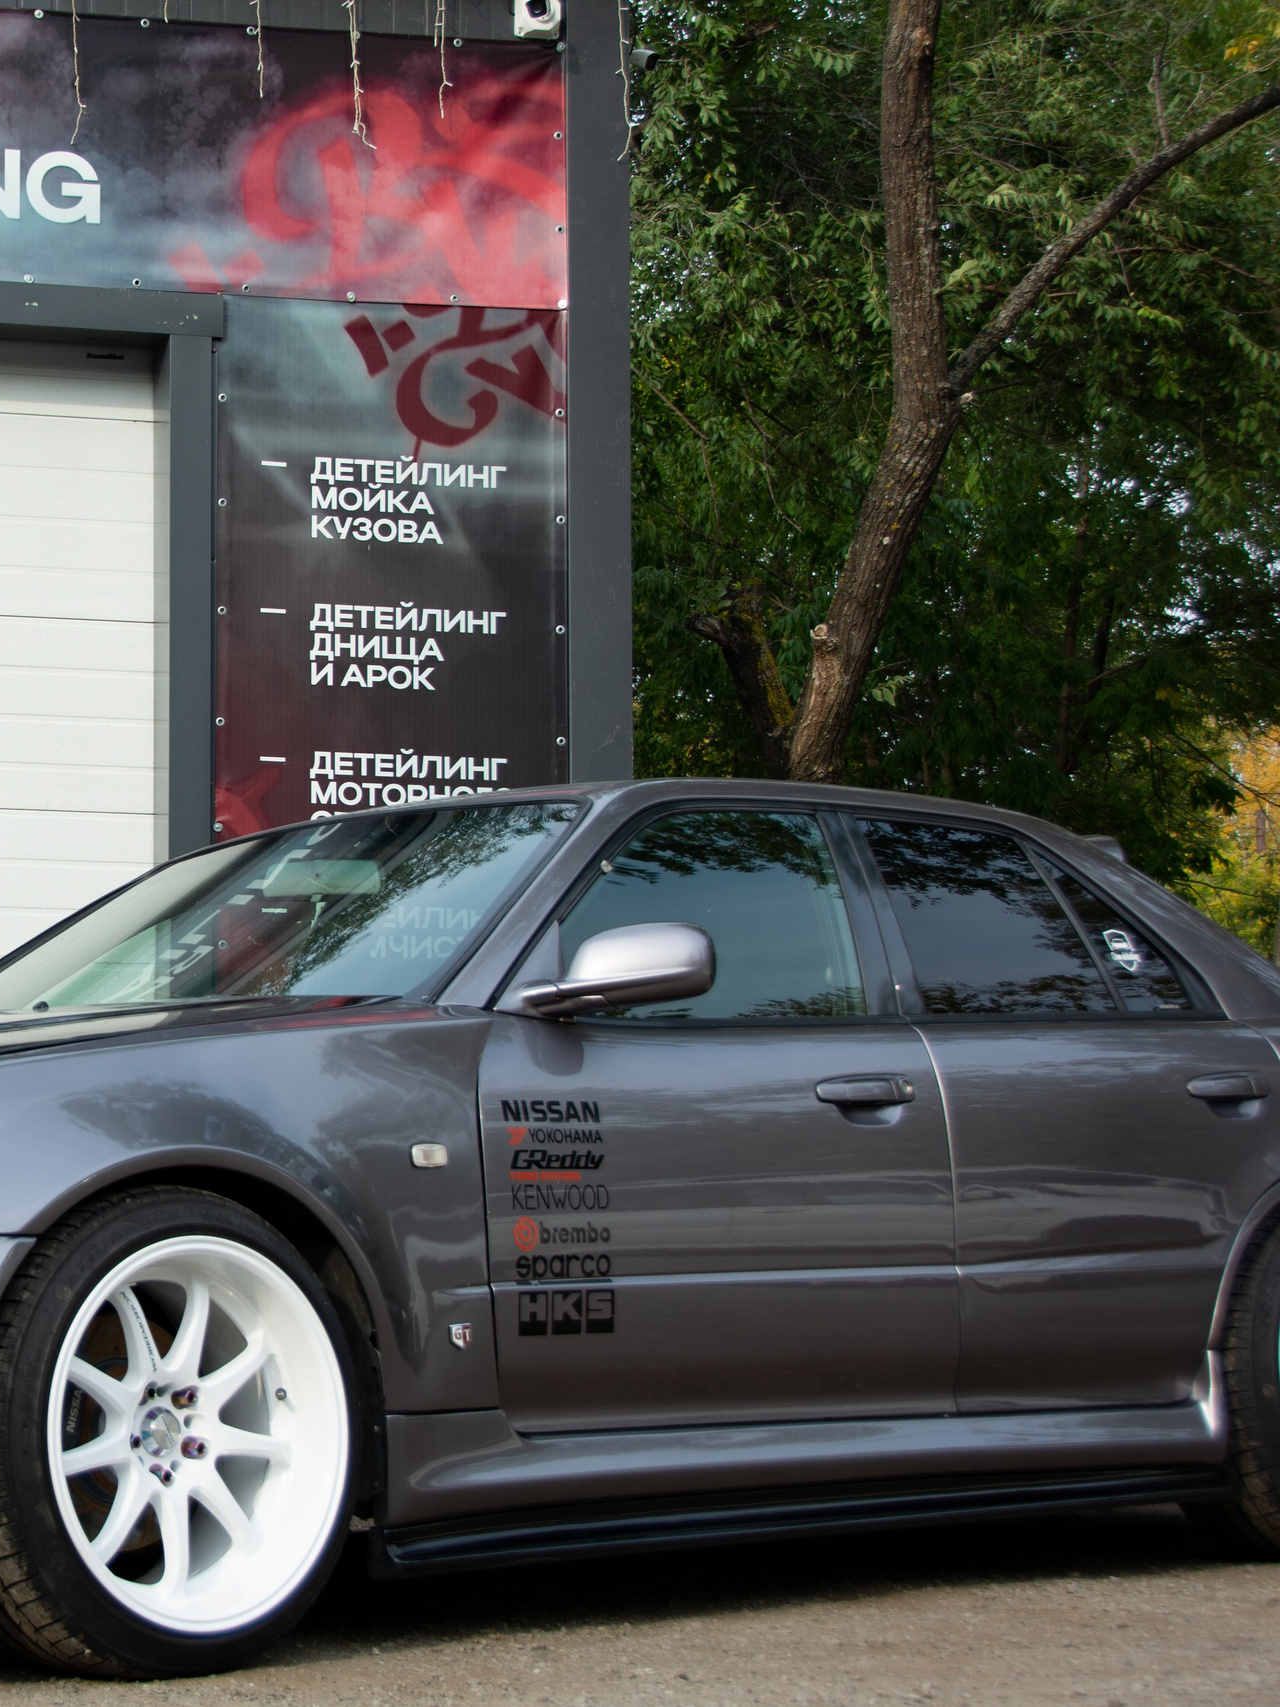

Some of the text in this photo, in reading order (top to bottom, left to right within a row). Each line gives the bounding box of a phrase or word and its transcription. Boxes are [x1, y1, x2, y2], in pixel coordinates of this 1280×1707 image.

[310, 456, 507, 489] ДЕТЕЙЛИНГ
[311, 484, 435, 515] МОЙКА
[311, 516, 444, 545] КУЗОВА
[309, 602, 507, 634] ДЕТЕЙЛИНГ
[309, 634, 445, 665] ДНИЩА
[311, 662, 436, 691] И АРОК
[309, 749, 508, 781] ДЕТЕЙЛИНГ
[500, 1100, 600, 1123] NISSAN
[528, 1129, 603, 1144] YOKOHAMA
[510, 1149, 605, 1169] GReddy
[509, 1171, 581, 1181] TURBO SYSTEMS
[511, 1184, 609, 1210] KENWOOD
[539, 1221, 611, 1244] brembo
[515, 1253, 611, 1279] sparco
[518, 1289, 615, 1335] HKS
[66, 1390, 83, 1432] NISSA
